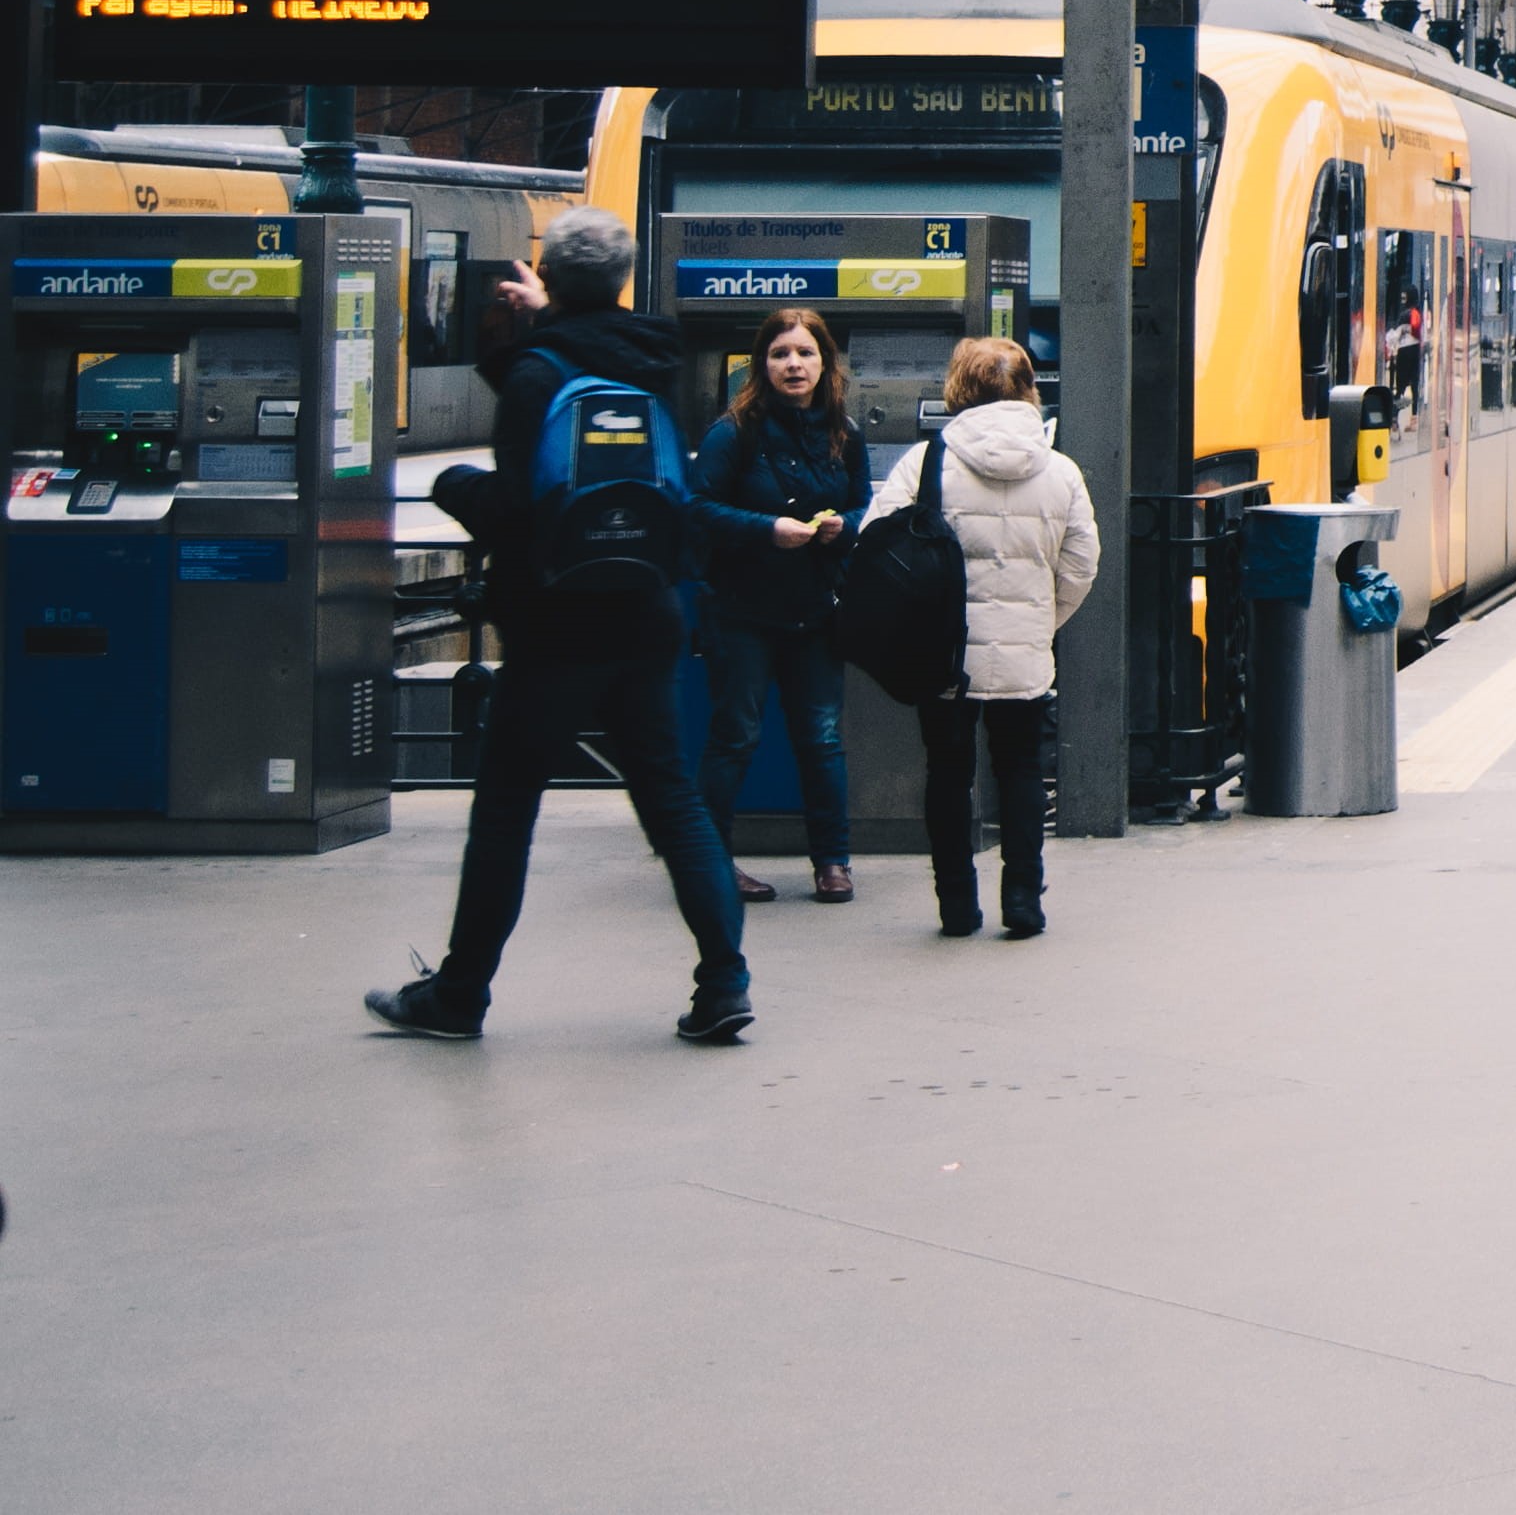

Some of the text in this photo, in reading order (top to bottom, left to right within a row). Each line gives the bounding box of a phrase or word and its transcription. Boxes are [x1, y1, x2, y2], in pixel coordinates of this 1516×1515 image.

[737, 221, 756, 236] de
[761, 221, 845, 240] Transporte
[925, 231, 951, 249] C1
[256, 232, 281, 250] C1
[40, 269, 144, 294] andante
[703, 269, 808, 295] andante
